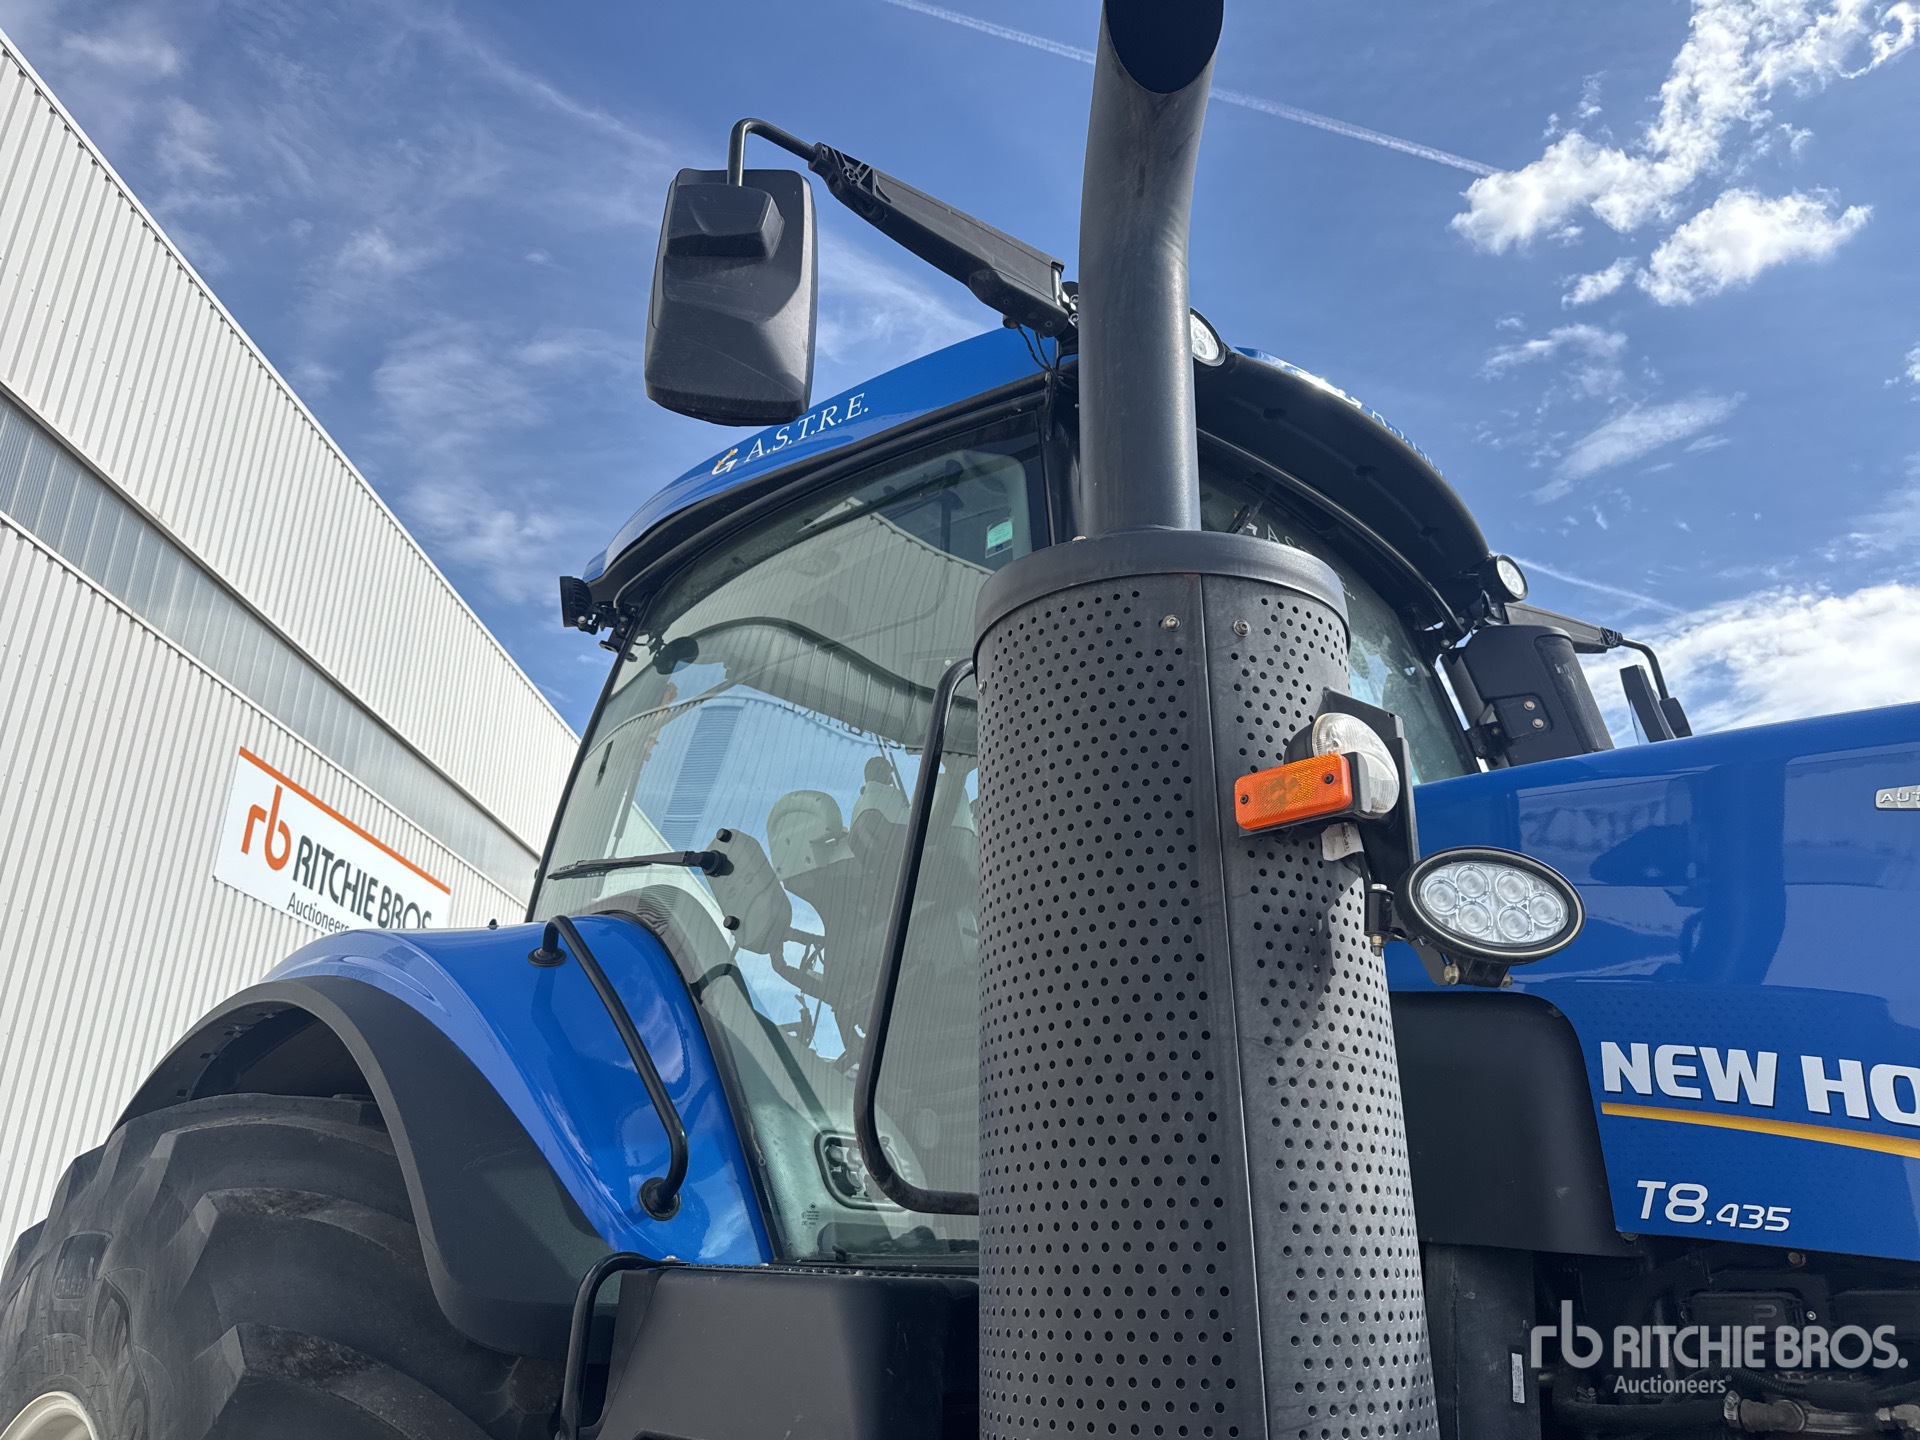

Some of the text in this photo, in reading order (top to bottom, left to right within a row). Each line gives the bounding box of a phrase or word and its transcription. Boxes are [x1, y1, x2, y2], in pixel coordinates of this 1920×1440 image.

[744, 392, 869, 463] A.S.T.R.E.
[241, 784, 292, 871] rb
[292, 835, 379, 922] RITCHIE
[1600, 1041, 1778, 1108] NEW
[1636, 1180, 1792, 1233] T8.435
